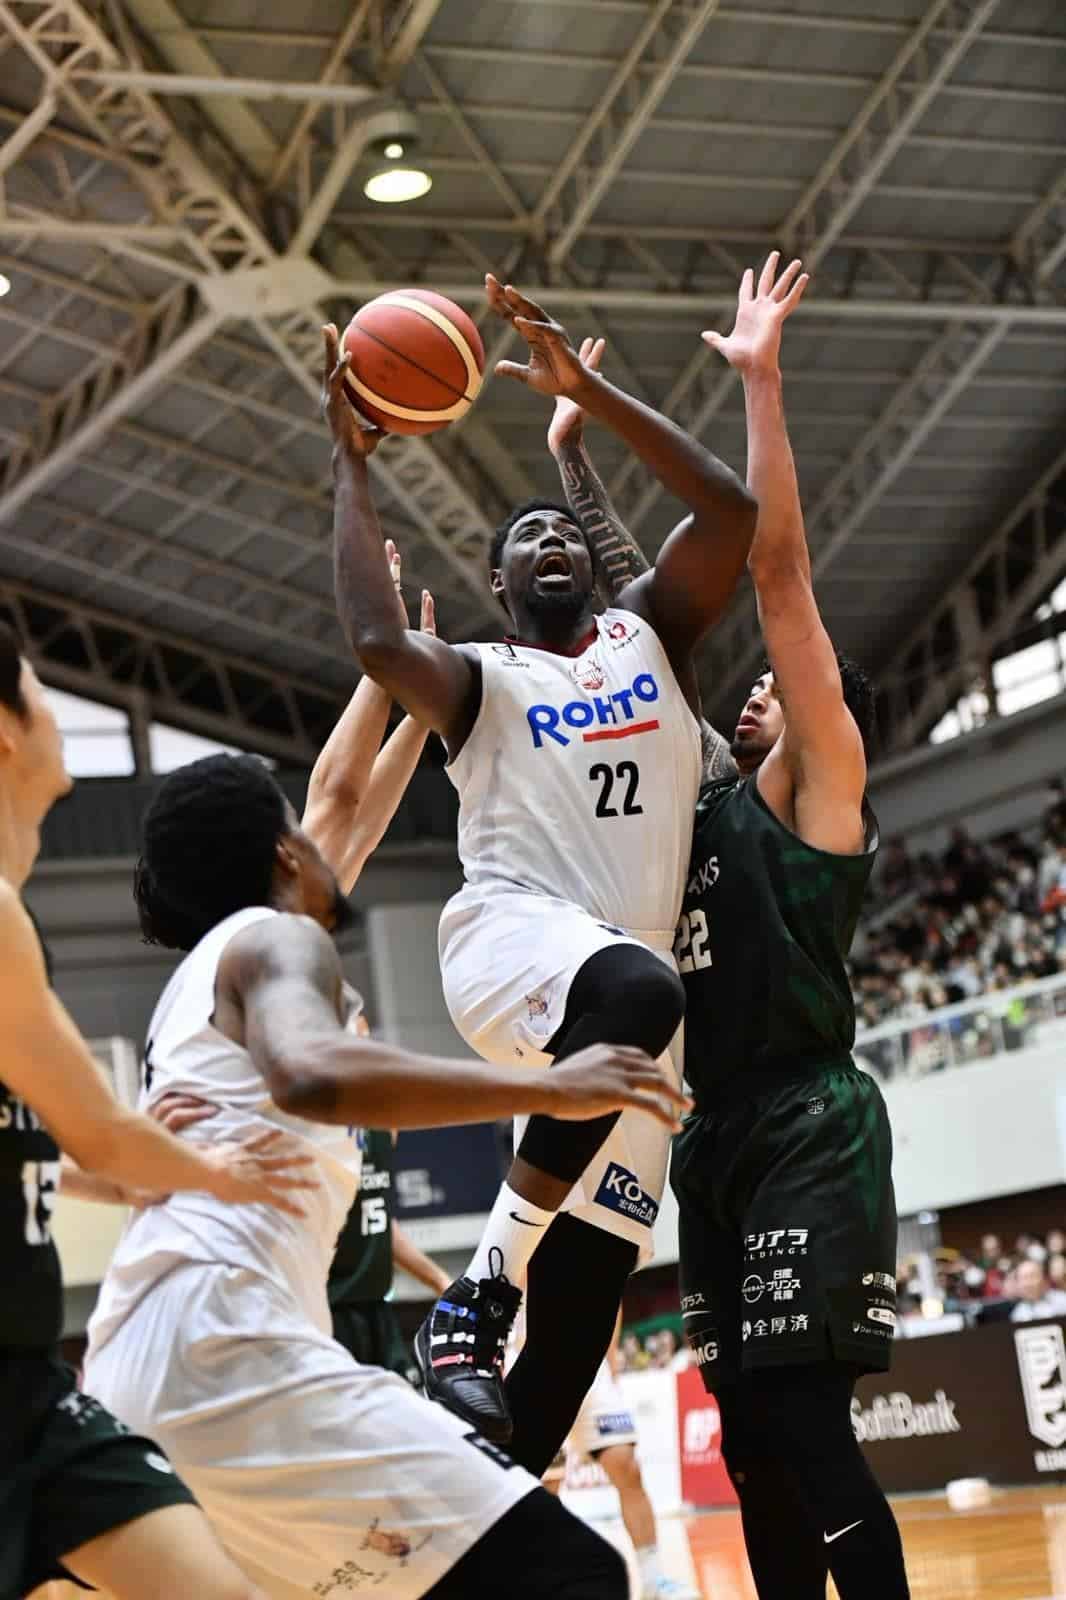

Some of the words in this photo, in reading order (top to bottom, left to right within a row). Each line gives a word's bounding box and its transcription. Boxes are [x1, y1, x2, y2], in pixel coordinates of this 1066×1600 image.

[526, 674, 659, 748] ROHTO
[589, 761, 643, 818] 22
[673, 908, 712, 974] 22
[361, 1197, 388, 1235] 15
[743, 1248, 808, 1262] LDINGS
[744, 1229, 808, 1251] ジアラ
[766, 1279, 801, 1292] プリンス
[752, 1314, 809, 1337] 全厚済
[850, 1388, 961, 1443] SoftBank
